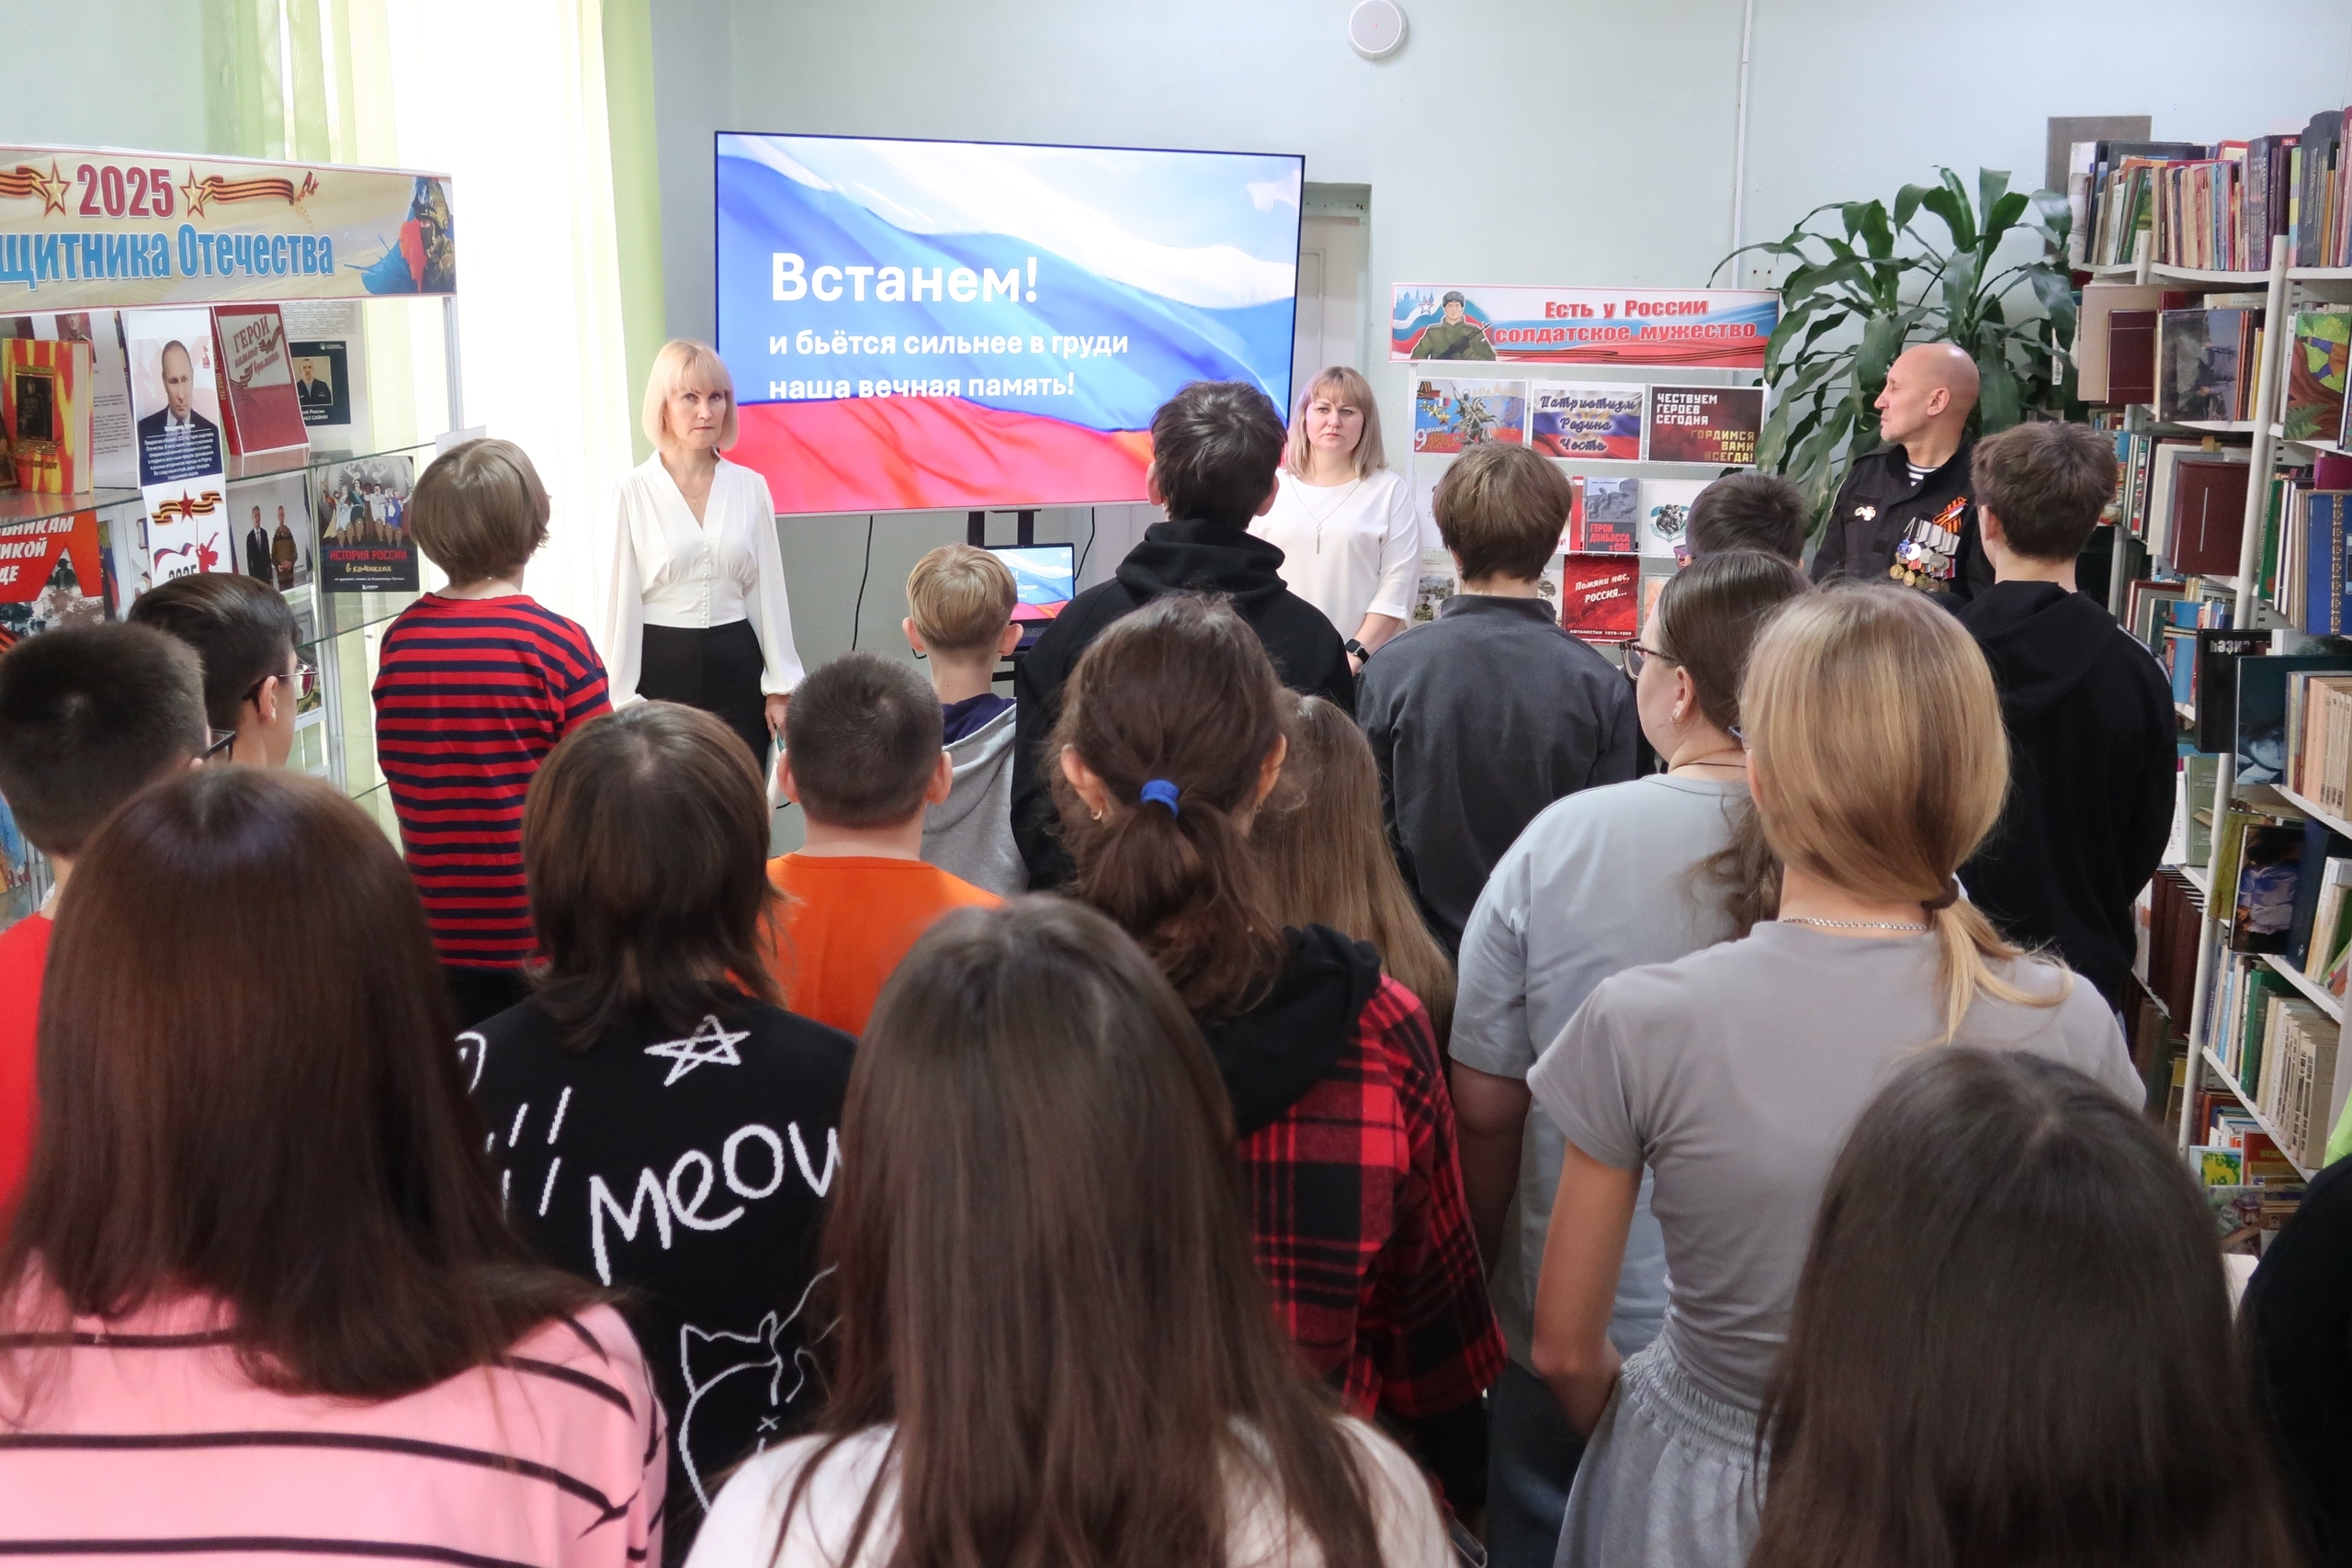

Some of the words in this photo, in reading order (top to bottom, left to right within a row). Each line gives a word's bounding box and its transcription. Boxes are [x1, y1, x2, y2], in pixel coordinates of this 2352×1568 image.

[76, 164, 175, 218] 2025
[176, 222, 335, 278] Отечества
[772, 252, 1037, 303] Встанем!
[1545, 300, 1594, 319] Есть
[1603, 303, 1616, 319] у
[1625, 299, 1709, 318] России
[232, 315, 270, 354] ГЕРОИ
[1495, 326, 1631, 344] солдатское
[1640, 322, 1757, 342] мужество
[769, 335, 787, 355] и
[796, 329, 896, 355] бьётся
[903, 335, 1023, 355] сильнее
[1030, 335, 1045, 354] в
[1051, 335, 1128, 359] груди
[769, 379, 851, 399] наша
[858, 378, 960, 398] вечная
[968, 371, 1074, 396] память!
[1540, 395, 1636, 412] Патриотизм
[1657, 393, 1717, 404] ЧЕСТВУЕМ
[1657, 404, 1701, 414] ГЕРОЕВ
[1559, 417, 1612, 433] Родина
[1656, 414, 1709, 425] СЕГОДНЯ
[1415, 428, 1428, 451] 9
[1691, 430, 1755, 441] ГОРДИМСЯ
[1559, 437, 1607, 451] Честь
[1721, 441, 1754, 452] ВАМИ
[1704, 452, 1754, 463] ВСЕГДА!
[1590, 524, 1613, 533] ГЕРОИ
[1589, 533, 1631, 543] ДОНБАССА
[329, 550, 369, 560] ИСТОРИЯ
[371, 549, 408, 560] РОССИИ
[1614, 543, 1631, 551] СВО
[1575, 578, 1609, 591] Помяни
[1585, 588, 1627, 604] РОССИЯ...
